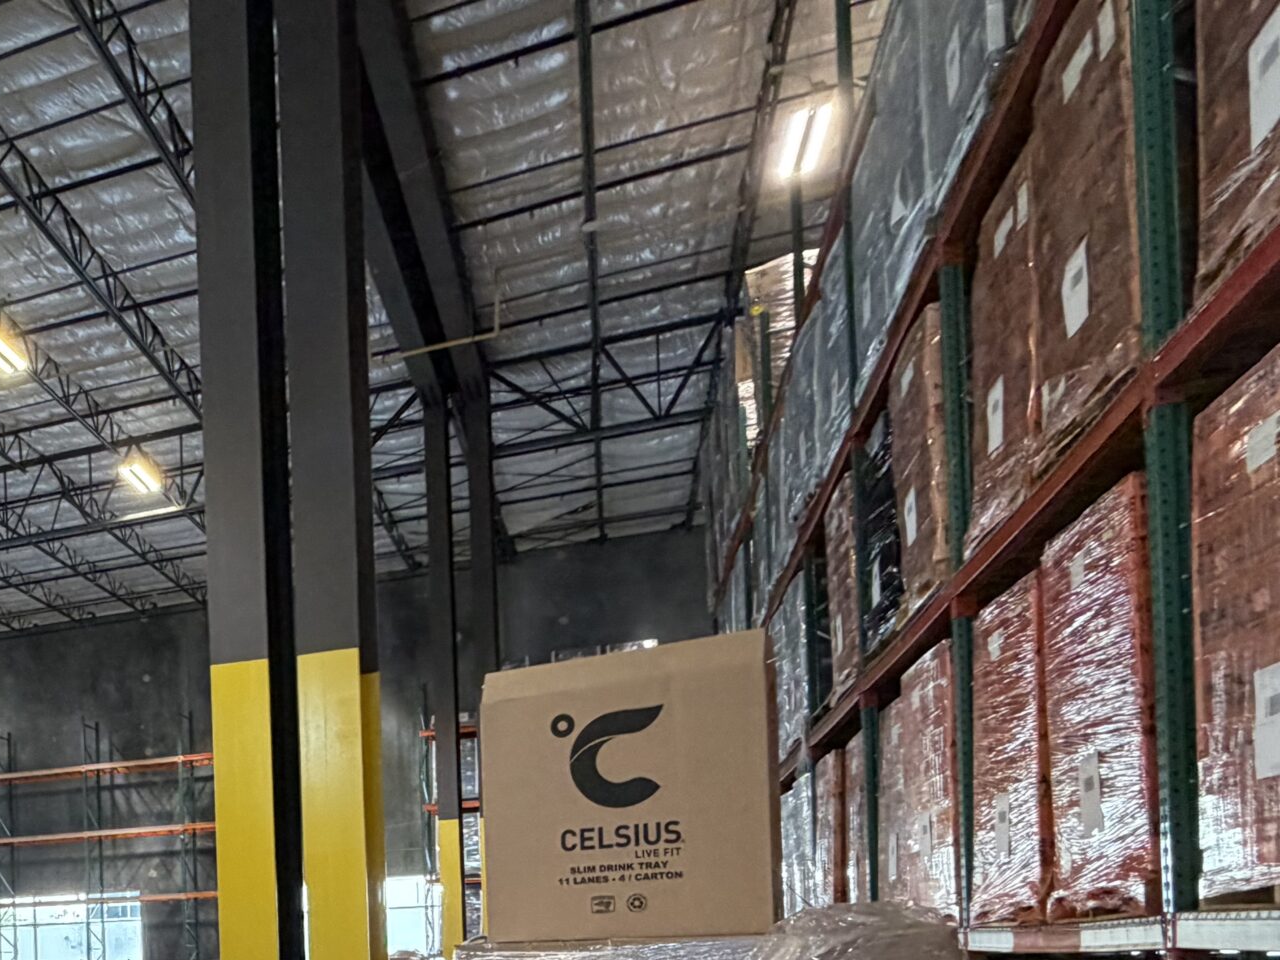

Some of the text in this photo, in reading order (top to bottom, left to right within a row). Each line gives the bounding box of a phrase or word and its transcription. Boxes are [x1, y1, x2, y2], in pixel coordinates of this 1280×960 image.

[561, 820, 682, 852] CELSIUS
[634, 847, 682, 859] LIVE FIT
[570, 860, 669, 875] SLIM DRINK TRAY
[558, 877, 570, 886] 11
[573, 875, 609, 885] LANES
[617, 874, 626, 883] 4
[634, 871, 684, 882] CARTON
